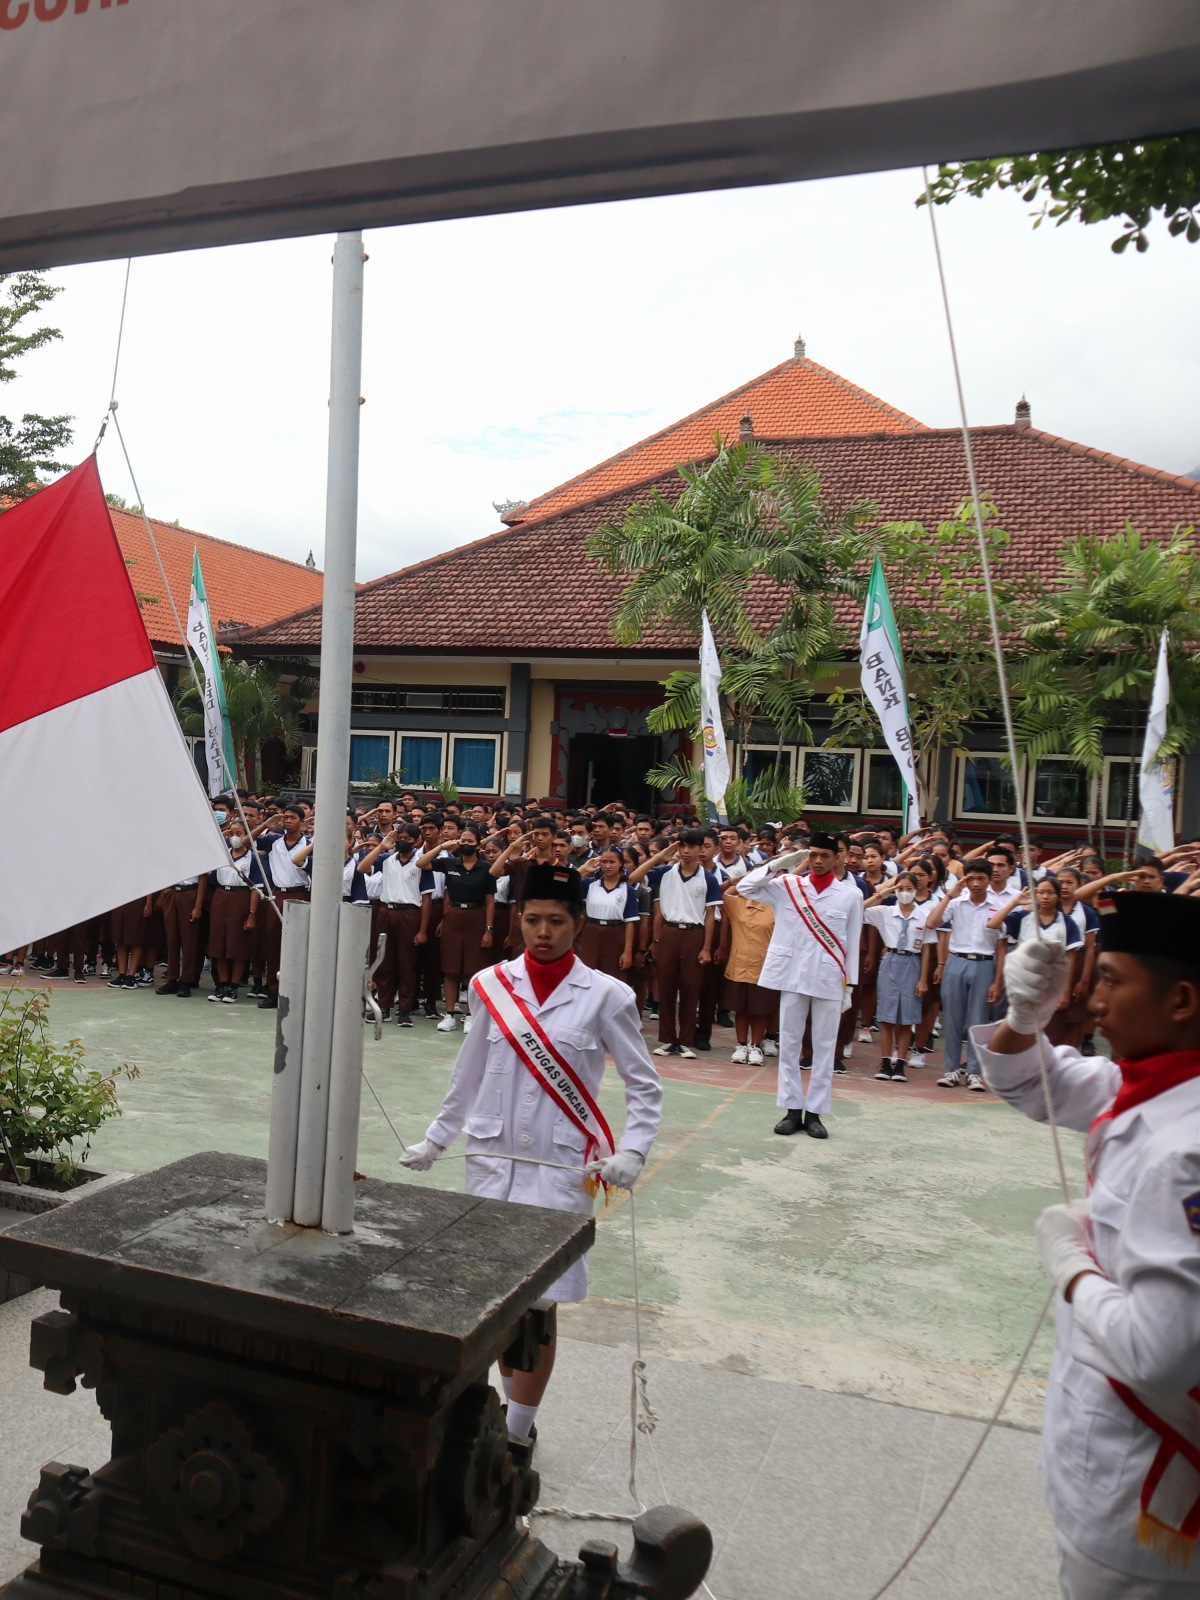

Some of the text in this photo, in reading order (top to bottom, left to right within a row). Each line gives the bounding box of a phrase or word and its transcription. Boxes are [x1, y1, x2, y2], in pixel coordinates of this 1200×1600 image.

[802, 907, 836, 948] PETUGAS UPACARA
[521, 1032, 590, 1122] PETUGAS UPACARA
